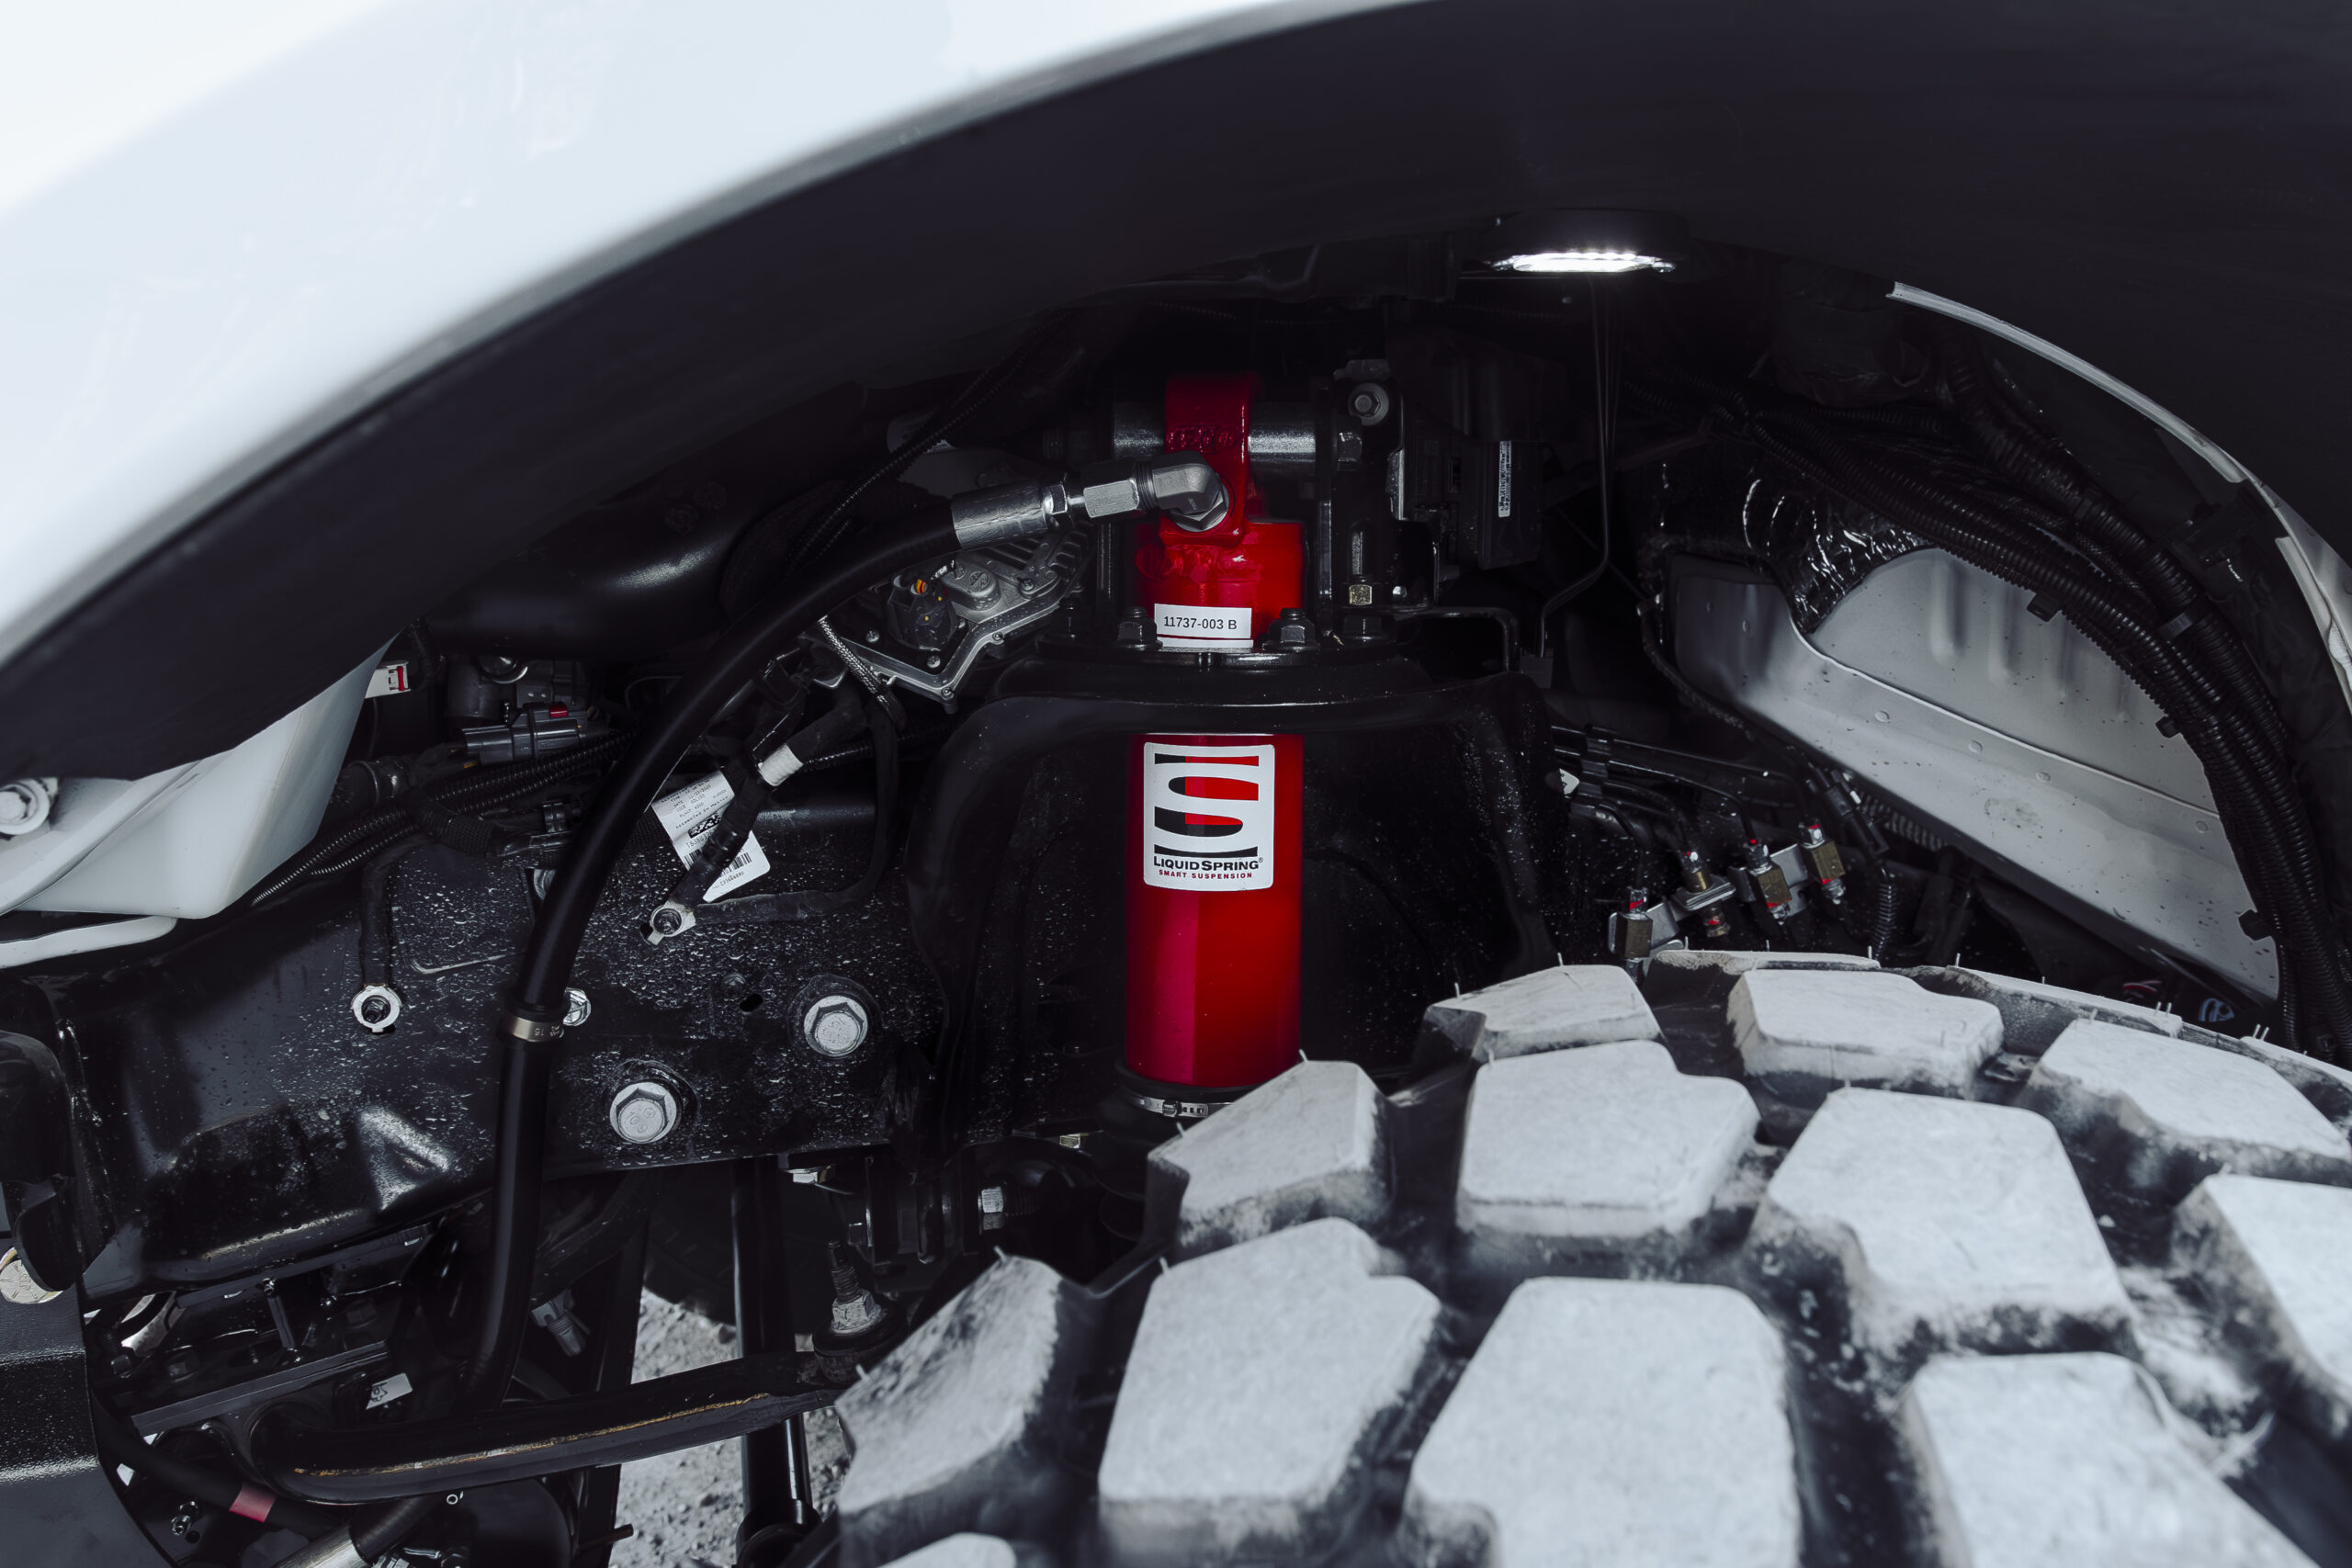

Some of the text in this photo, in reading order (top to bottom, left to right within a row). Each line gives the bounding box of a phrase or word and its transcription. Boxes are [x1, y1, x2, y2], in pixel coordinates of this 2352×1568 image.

[1163, 615, 1238, 630] 11737-003 B
[1159, 869, 1187, 878] SMART
